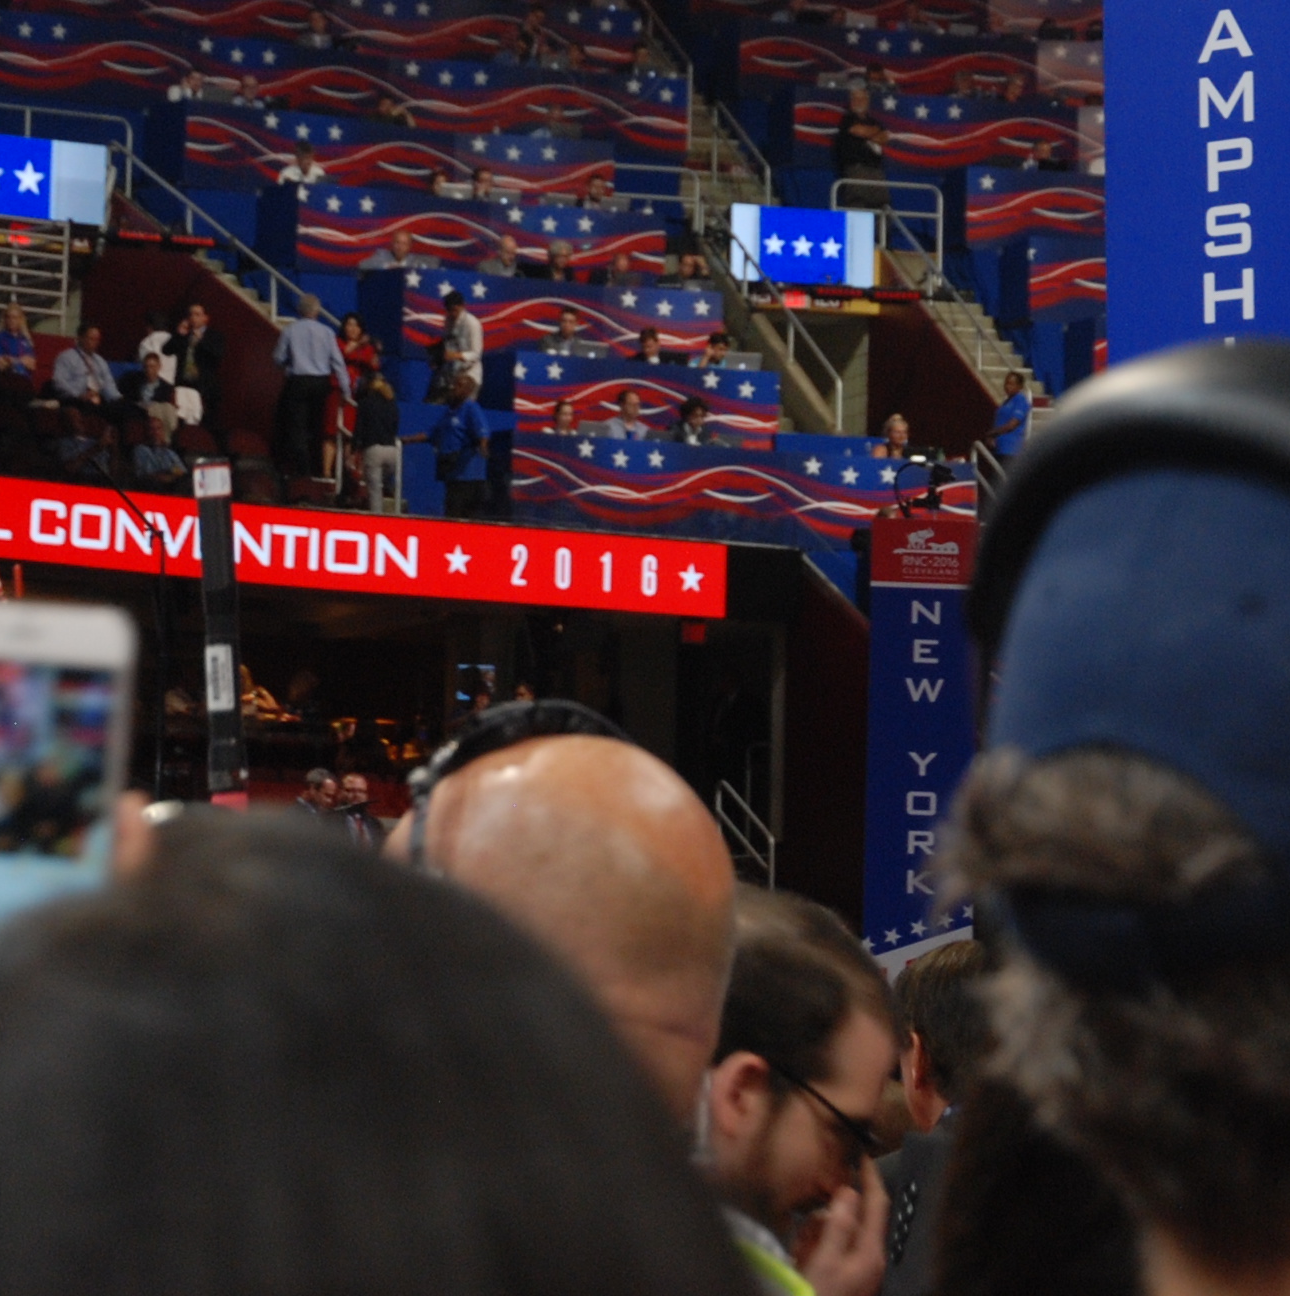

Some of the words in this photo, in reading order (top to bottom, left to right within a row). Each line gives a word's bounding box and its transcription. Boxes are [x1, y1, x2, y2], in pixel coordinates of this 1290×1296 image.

[29, 497, 419, 579] CONVNTION
[510, 543, 658, 597] 2016
[905, 600, 944, 702] NEW
[905, 751, 939, 895] YORK
